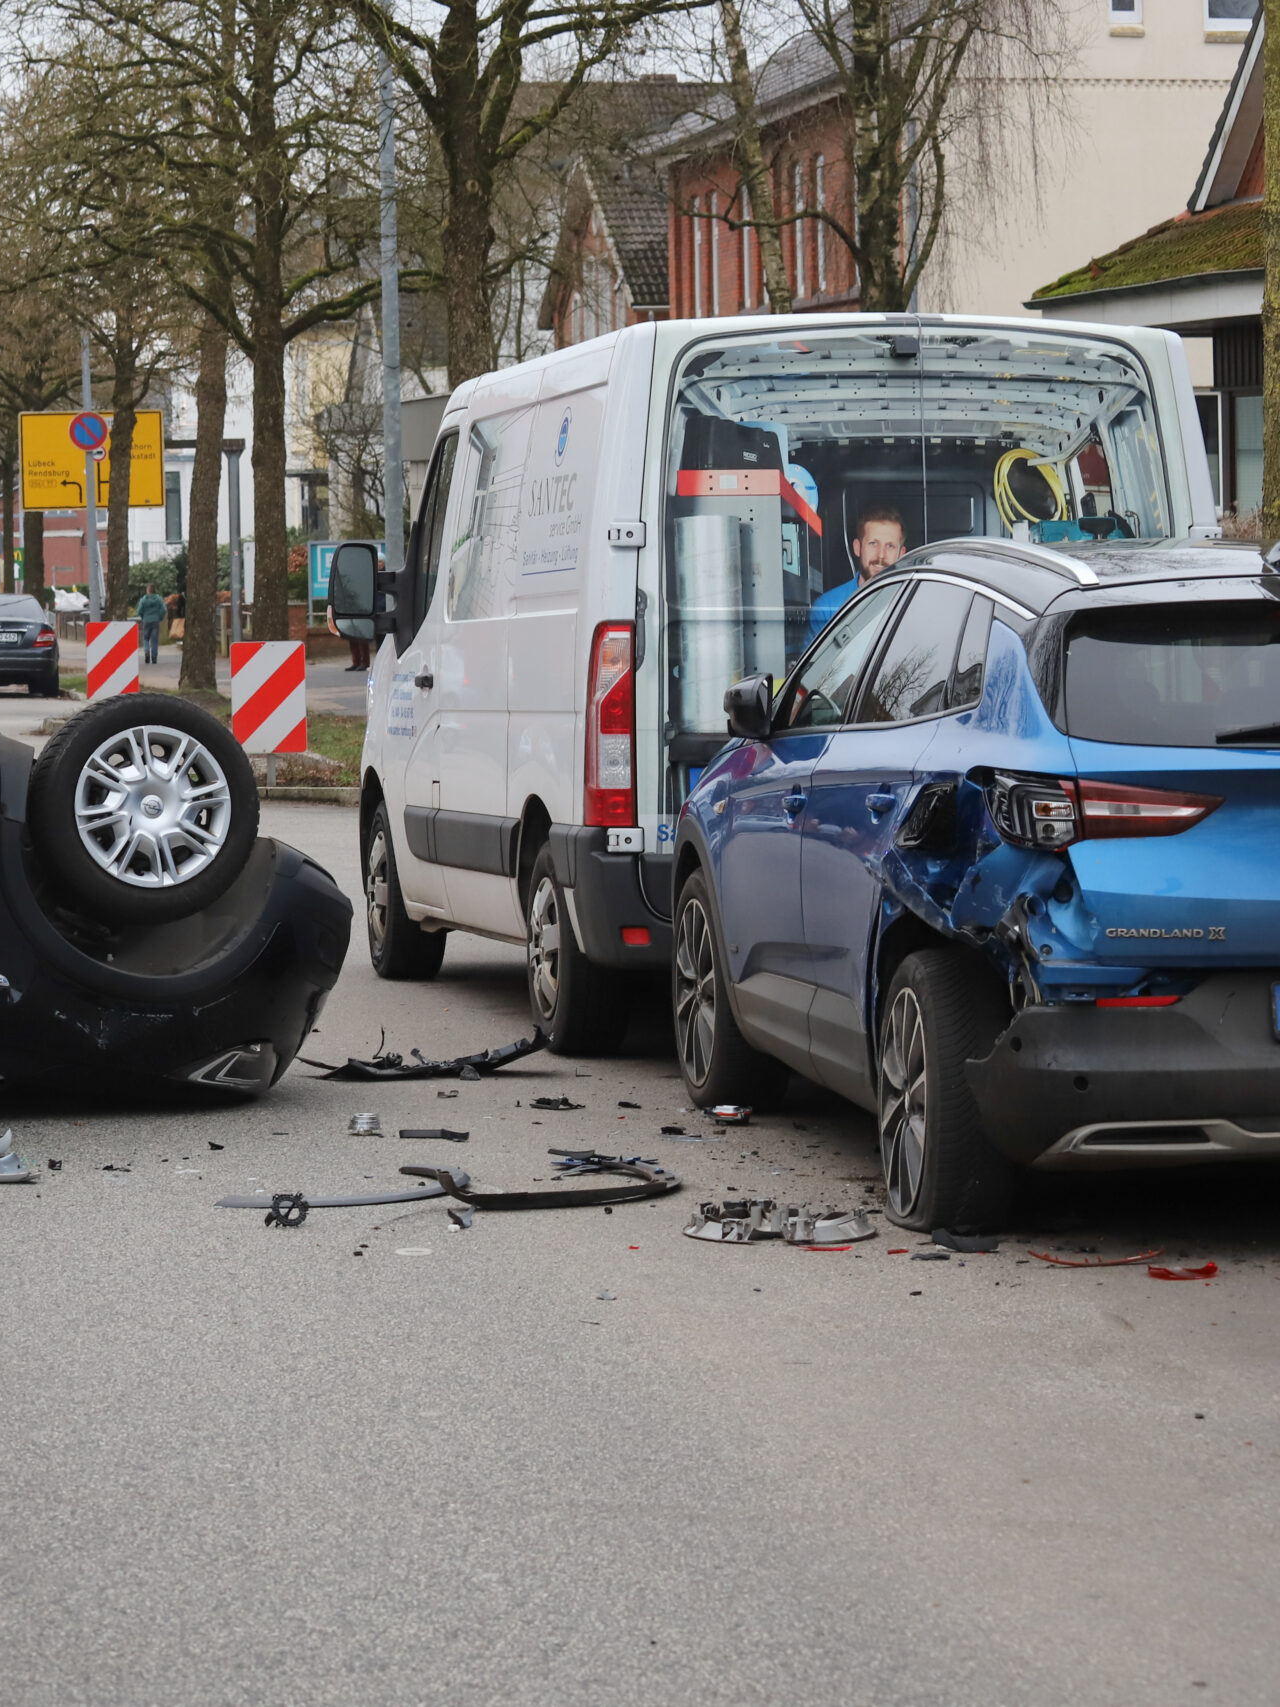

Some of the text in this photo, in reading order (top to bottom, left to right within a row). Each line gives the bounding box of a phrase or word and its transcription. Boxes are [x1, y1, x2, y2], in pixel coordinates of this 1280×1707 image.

[28, 459, 55, 467] Lübeck
[28, 468, 70, 477] Rendsburg
[528, 472, 578, 518] SANTEC
[1105, 926, 1226, 940] GRANDLAND X
